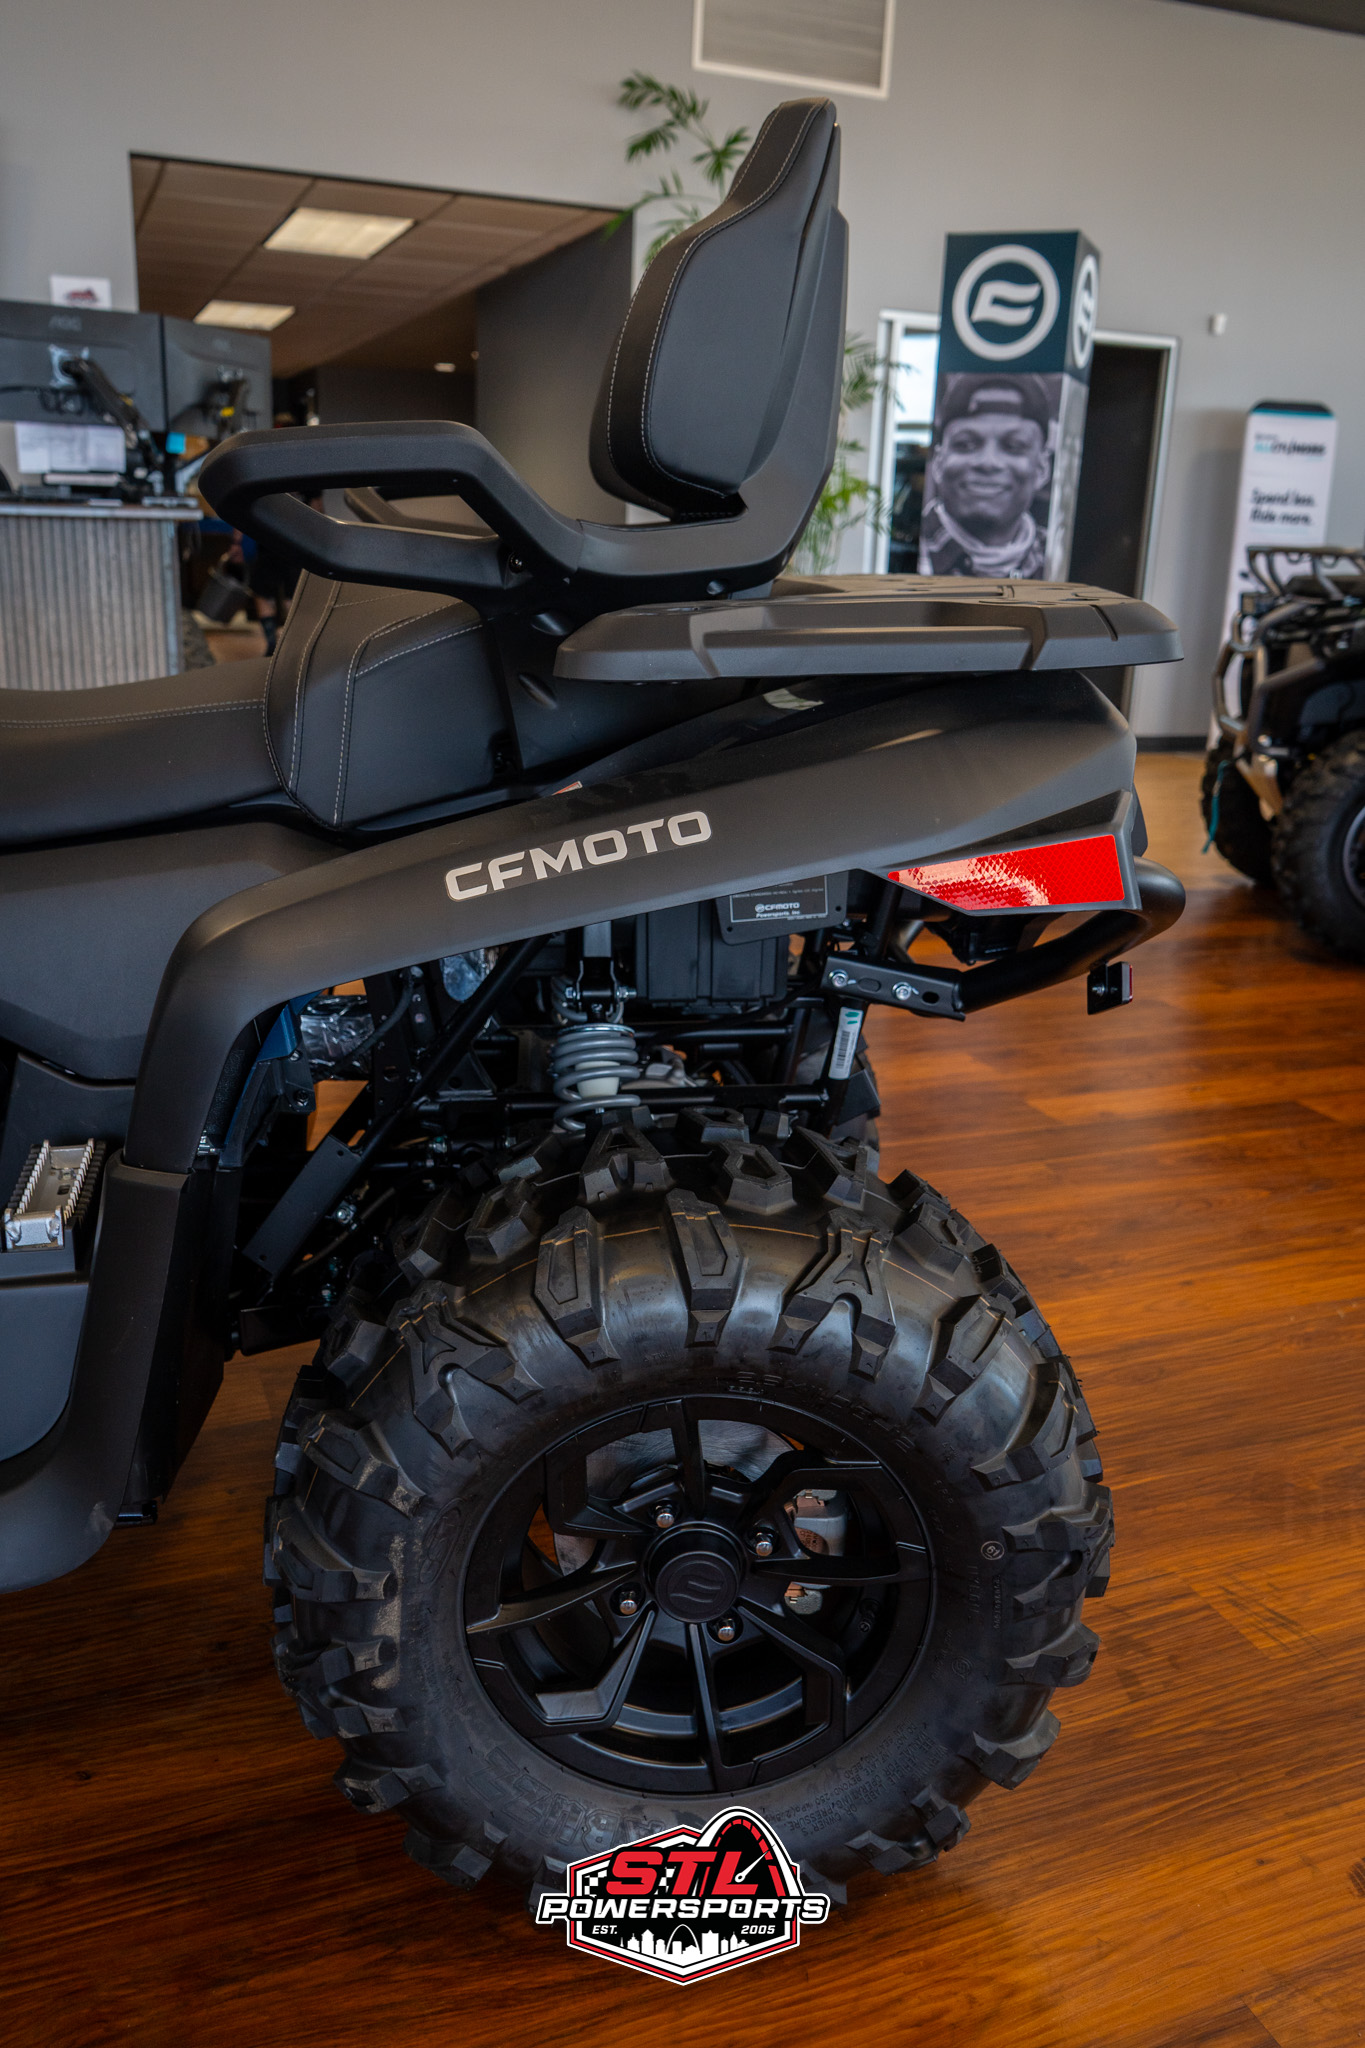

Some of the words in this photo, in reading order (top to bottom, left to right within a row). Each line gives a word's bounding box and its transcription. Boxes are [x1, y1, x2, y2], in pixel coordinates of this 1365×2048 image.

[446, 811, 711, 900] CFMOTO
[765, 902, 800, 911] CFMOTO
[842, 1761, 864, 1779] BEAD
[881, 1759, 901, 1776] FOR
[832, 1773, 863, 1796] BEYOND
[858, 1782, 888, 1806] LABEL
[843, 1803, 858, 1816] OR
[800, 1811, 842, 1837] OWNER'S
